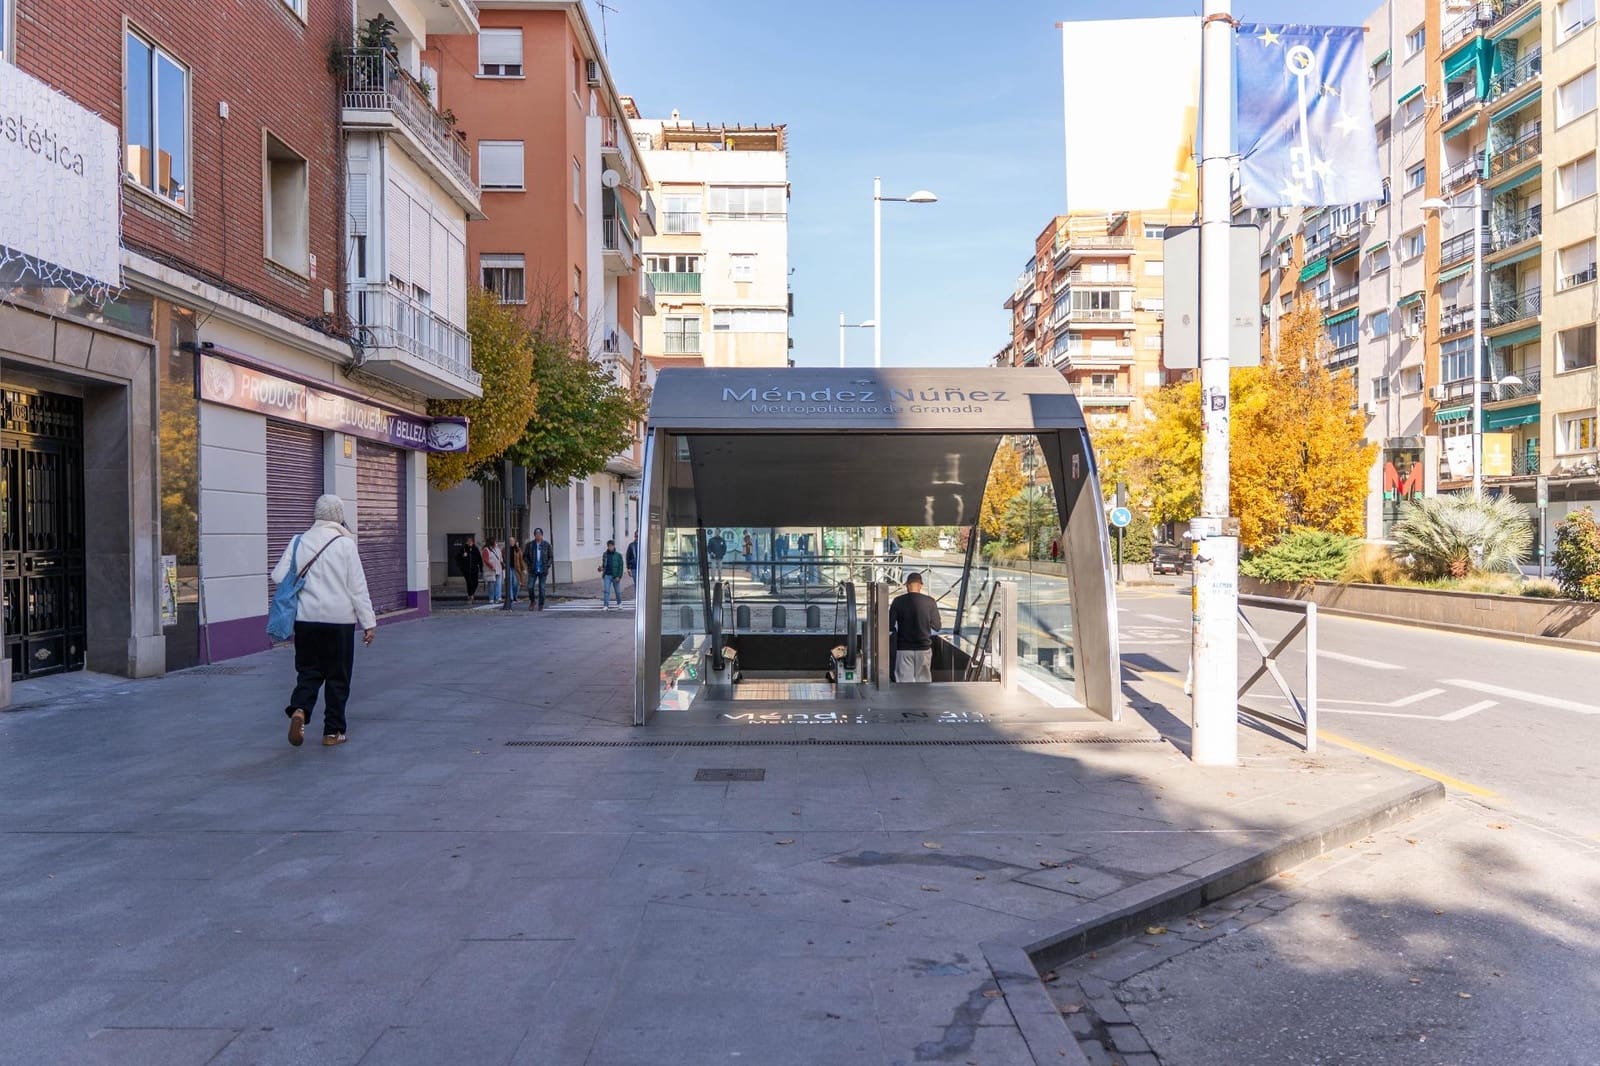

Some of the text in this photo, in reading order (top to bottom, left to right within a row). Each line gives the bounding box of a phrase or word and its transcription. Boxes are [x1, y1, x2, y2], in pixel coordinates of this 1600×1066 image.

[0, 114, 83, 176] stética
[240, 375, 316, 414] PRODUCTOS
[388, 416, 395, 436] Y
[396, 420, 427, 443] BELLEZA
[721, 386, 1010, 402] Méndez Núñez
[751, 404, 878, 416] Metropolitano
[909, 404, 983, 414] Granada
